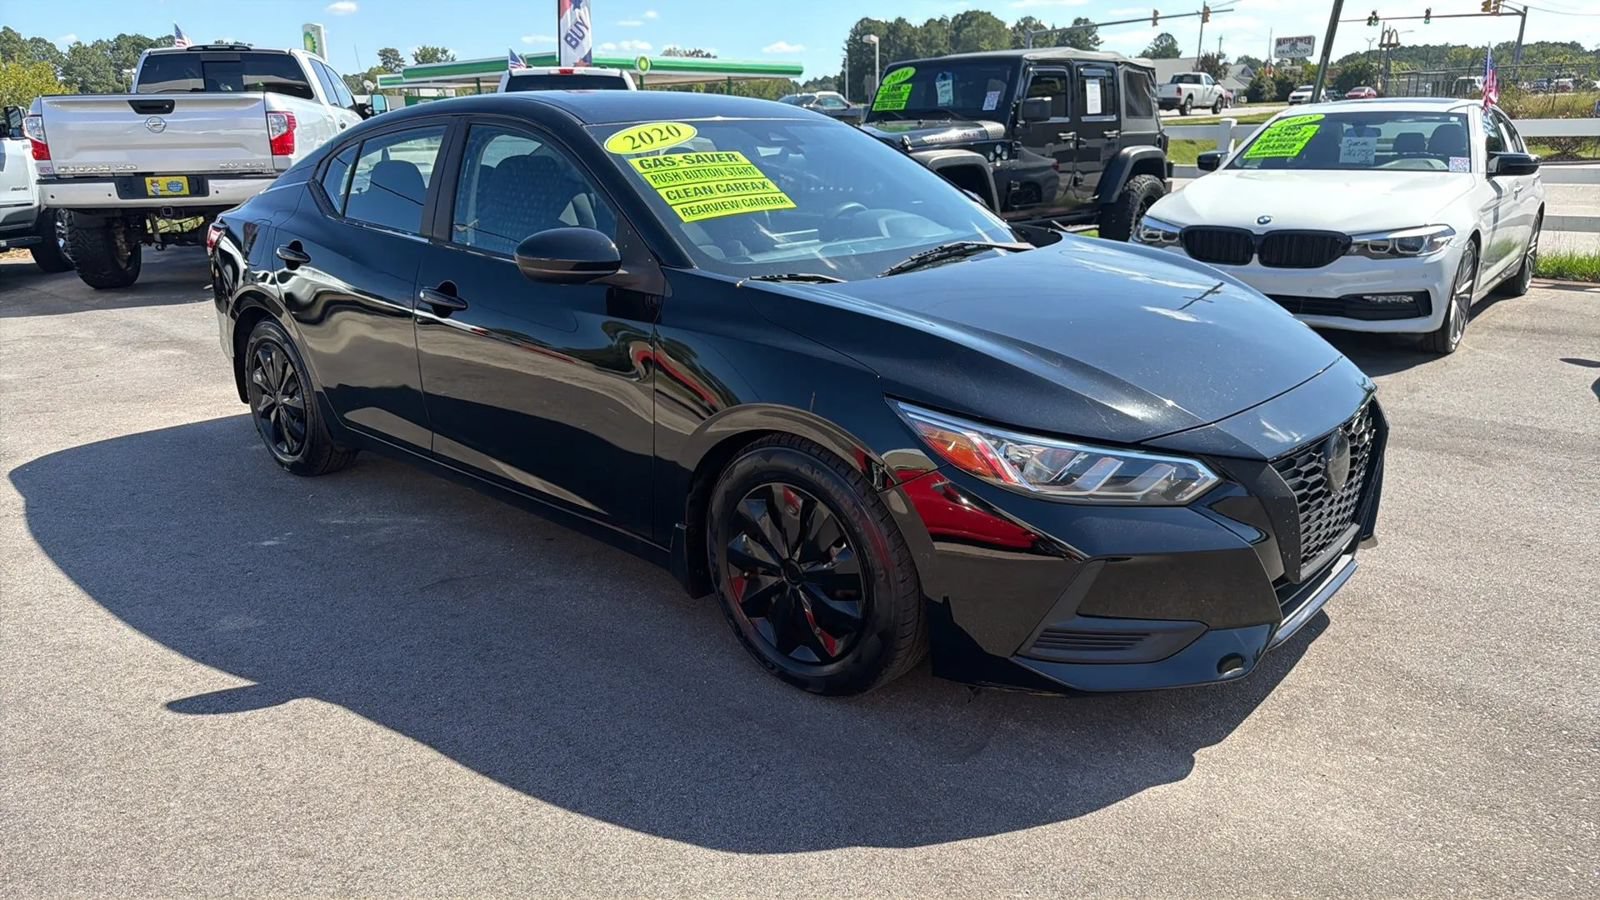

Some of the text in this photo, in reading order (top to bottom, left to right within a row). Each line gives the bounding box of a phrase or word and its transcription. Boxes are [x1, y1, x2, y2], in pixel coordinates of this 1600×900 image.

[564, 15, 589, 49] BUY
[623, 124, 682, 150] 2020
[638, 152, 740, 170] GAS-SAVER
[650, 171, 682, 185] PUSH
[684, 168, 723, 181] BUTTON
[666, 180, 770, 201] CLEAN CARFAX
[680, 194, 787, 217] REARVIEW CAMERA
